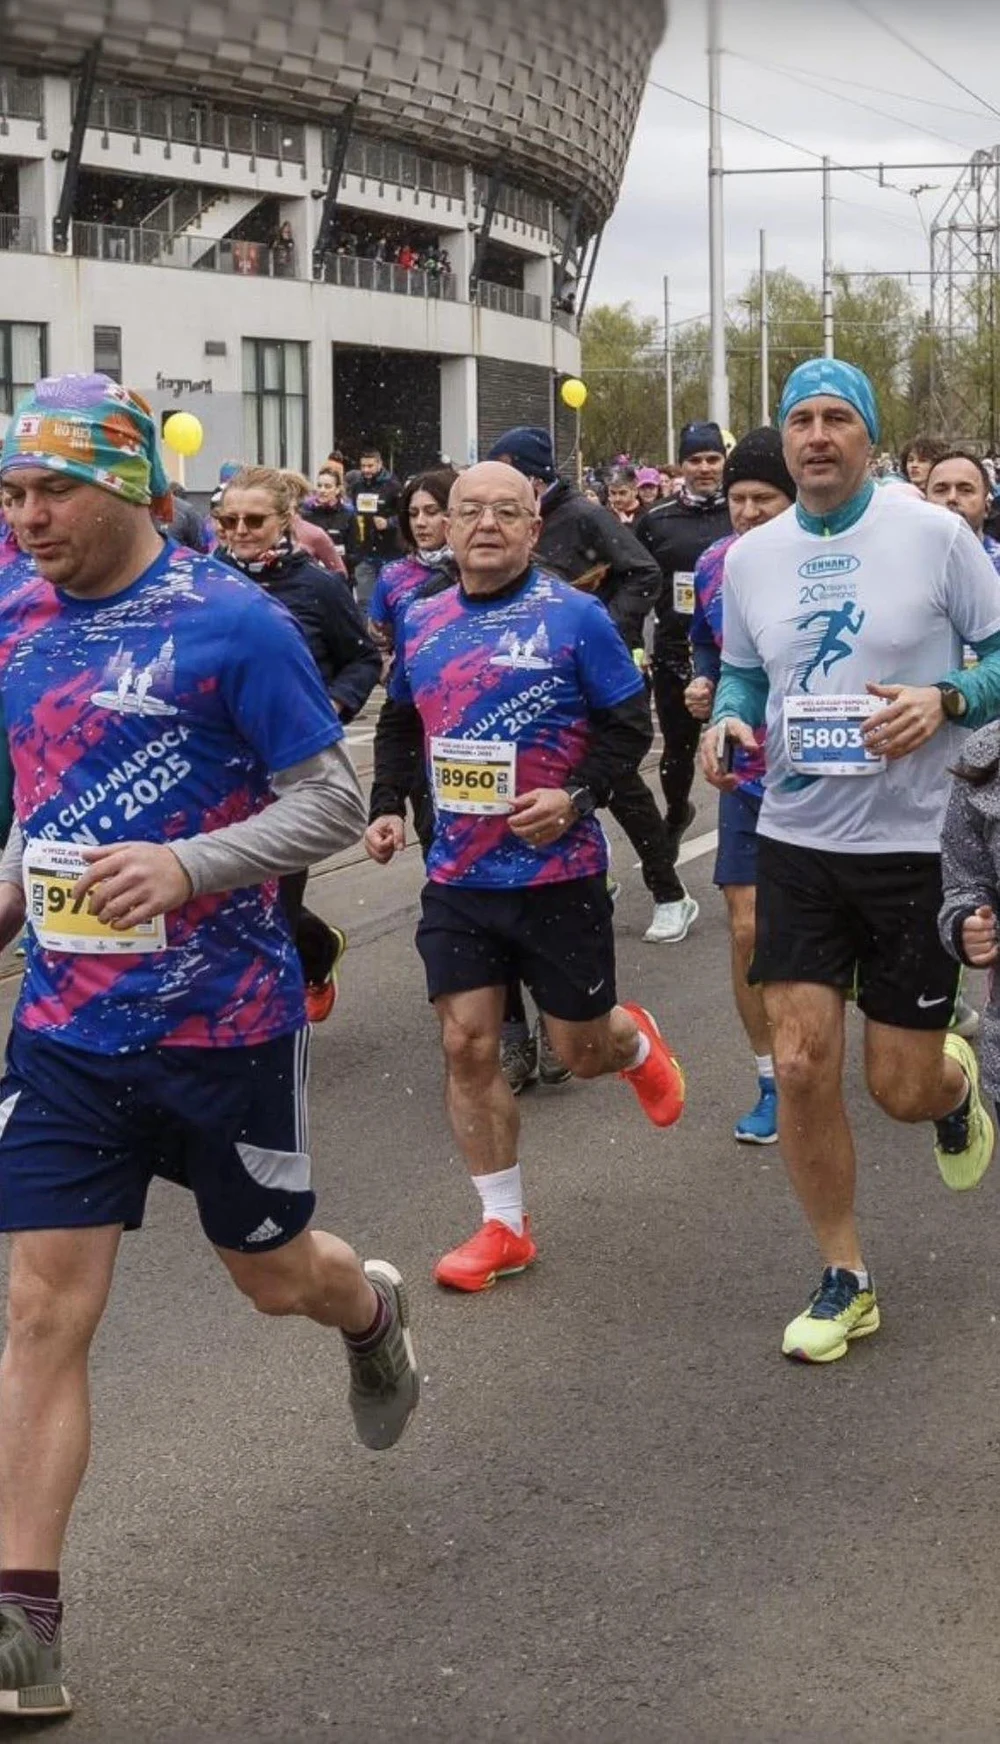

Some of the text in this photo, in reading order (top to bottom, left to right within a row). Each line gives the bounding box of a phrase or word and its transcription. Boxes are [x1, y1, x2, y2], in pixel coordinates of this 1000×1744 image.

[806, 558, 850, 574] TENNANT
[799, 583, 826, 604] 20
[462, 676, 566, 740] CLUJ-NAPOCA
[504, 695, 558, 735] 2025
[803, 728, 863, 748] 5803
[58, 724, 191, 828] CLUJ-NAPOCA
[116, 753, 192, 821] 2025
[441, 768, 495, 789] 8960
